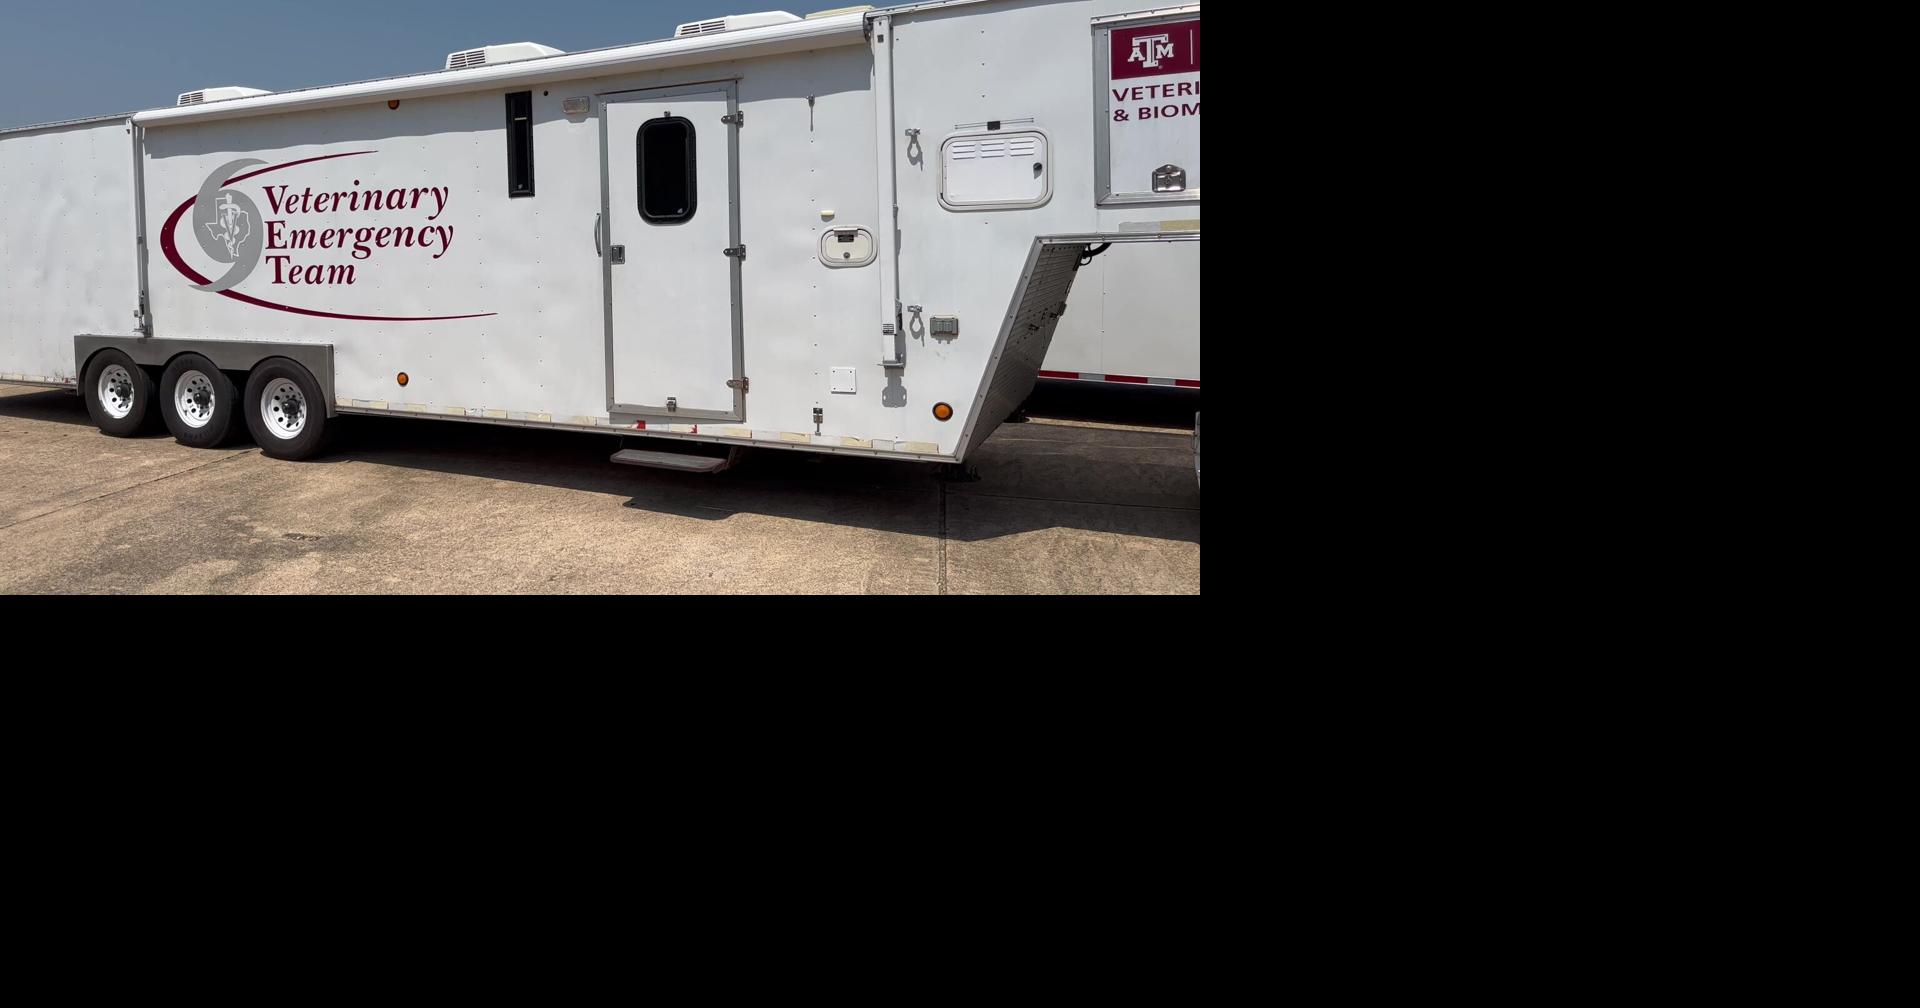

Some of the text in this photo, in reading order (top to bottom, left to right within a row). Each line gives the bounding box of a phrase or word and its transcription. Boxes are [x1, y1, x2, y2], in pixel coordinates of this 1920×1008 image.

[1113, 102, 1200, 122] & BIOM
[263, 179, 449, 220] Veterinary
[265, 220, 454, 259] Emergency
[265, 255, 357, 285] Team
